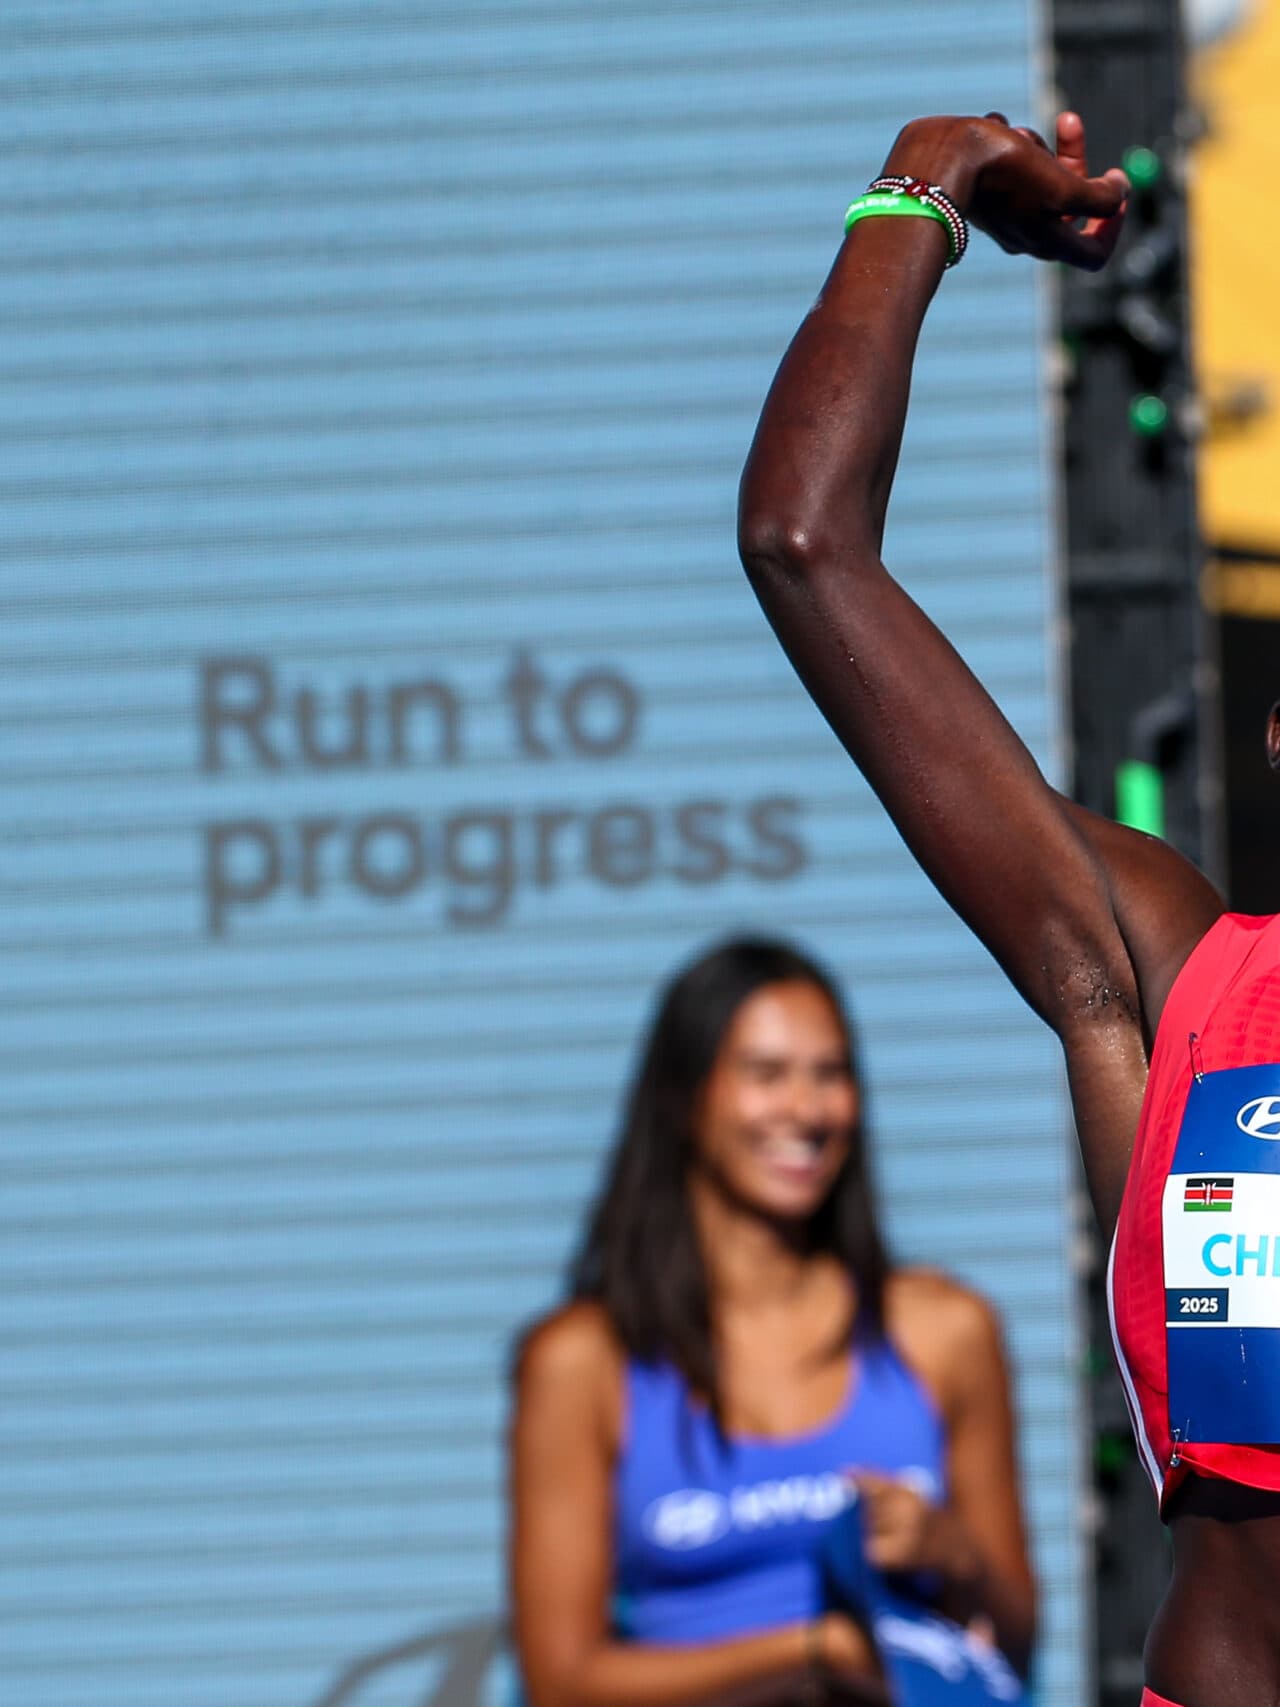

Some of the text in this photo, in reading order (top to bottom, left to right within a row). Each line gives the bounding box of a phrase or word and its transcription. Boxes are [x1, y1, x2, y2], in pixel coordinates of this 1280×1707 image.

[199, 642, 640, 775] Run to
[203, 793, 811, 940] progress
[1180, 1296, 1218, 1313] 2025
